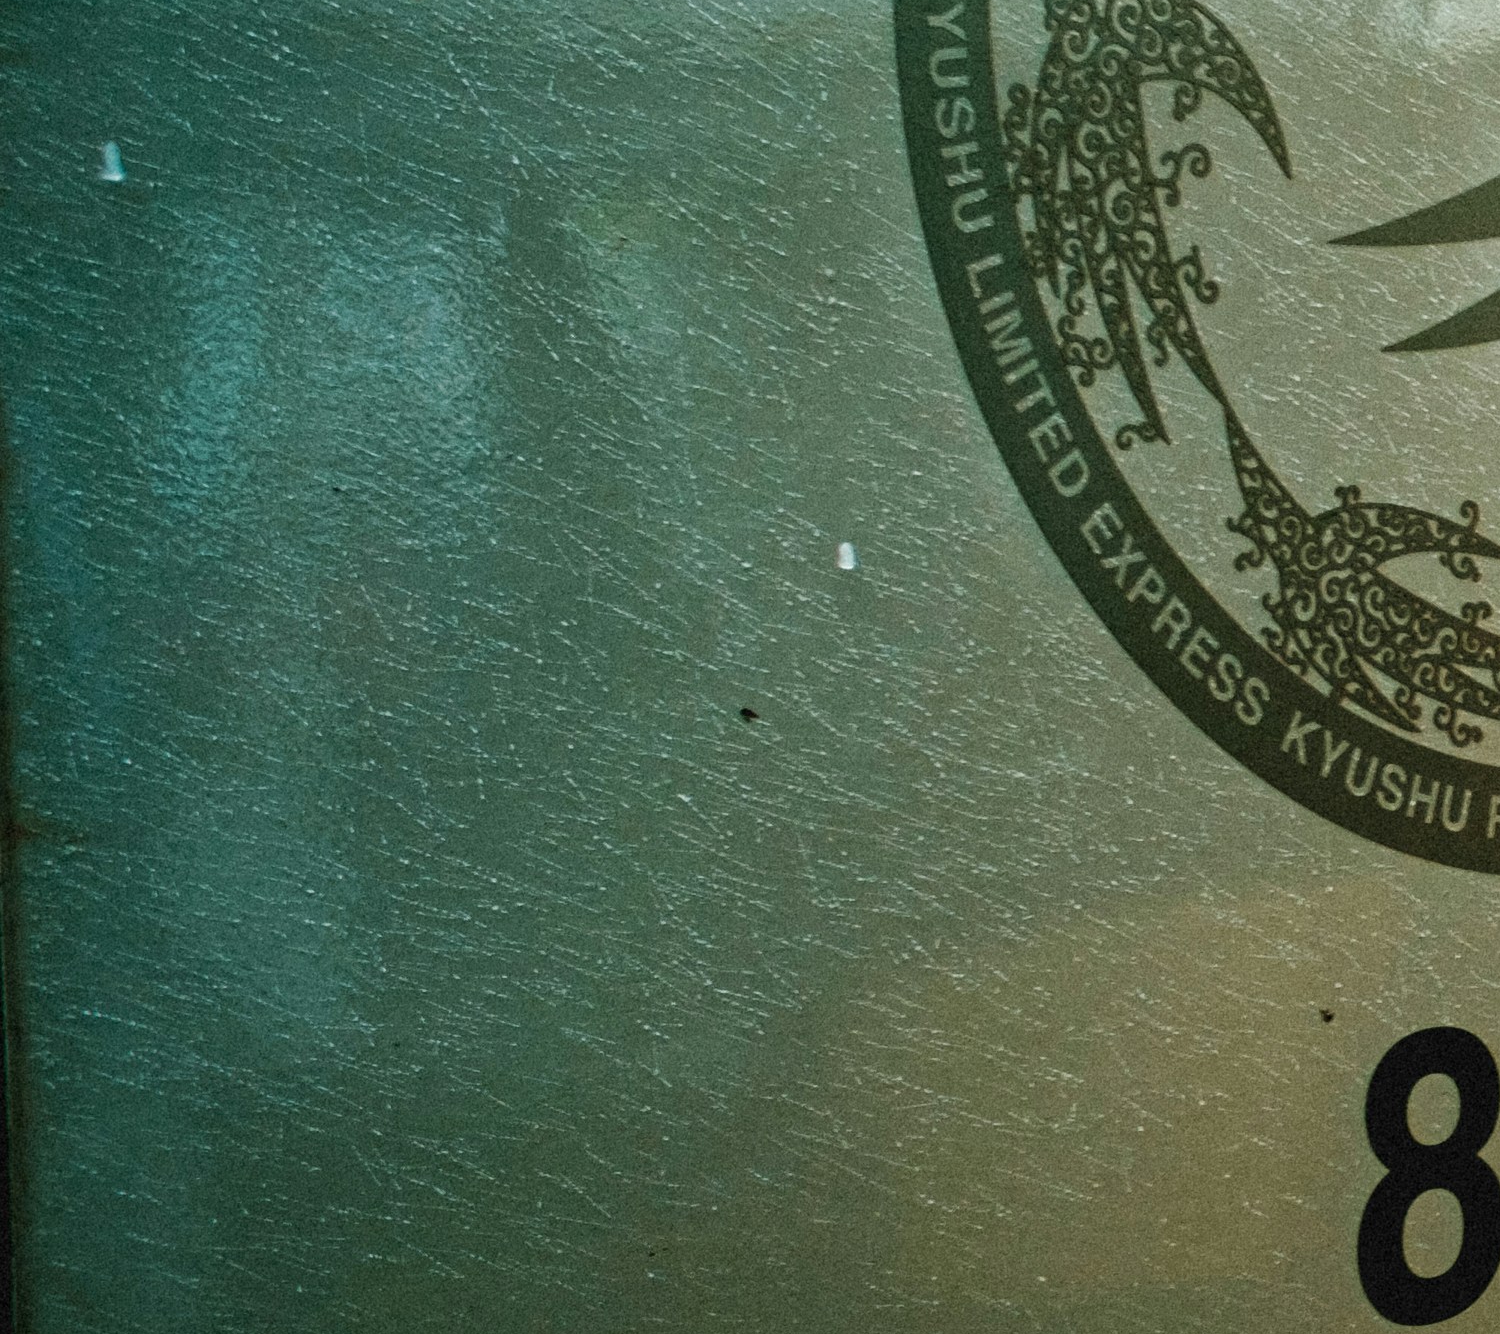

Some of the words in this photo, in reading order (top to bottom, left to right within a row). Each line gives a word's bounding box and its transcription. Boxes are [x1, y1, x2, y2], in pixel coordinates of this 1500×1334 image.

[965, 248, 1094, 508] LIMITED
[1079, 497, 1272, 733] EXPRESS
[1279, 705, 1470, 832] KYUSHU
